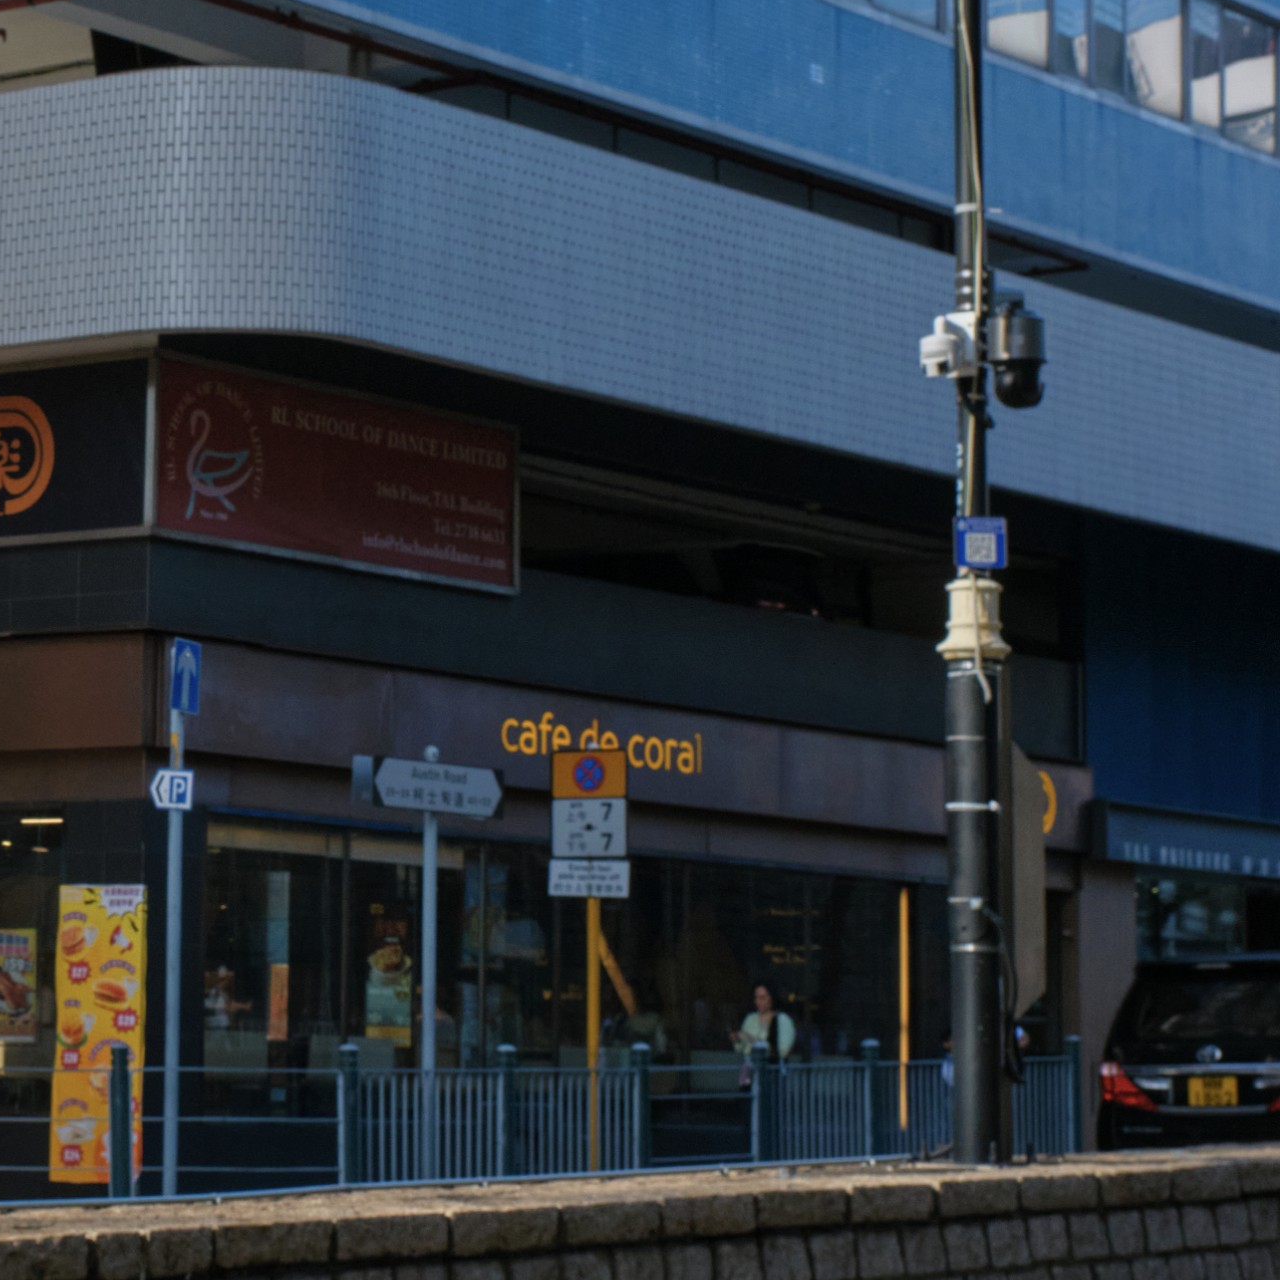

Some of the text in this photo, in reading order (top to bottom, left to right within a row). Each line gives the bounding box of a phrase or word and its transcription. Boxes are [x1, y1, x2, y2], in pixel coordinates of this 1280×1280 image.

[271, 404, 508, 471] RL SCHOOL OF DANCE LIMITED
[500, 711, 572, 756] cafe
[626, 732, 703, 775] coral
[411, 766, 468, 785] Austin Road
[172, 778, 186, 803] P
[601, 802, 613, 822] 7
[601, 833, 613, 852] 7
